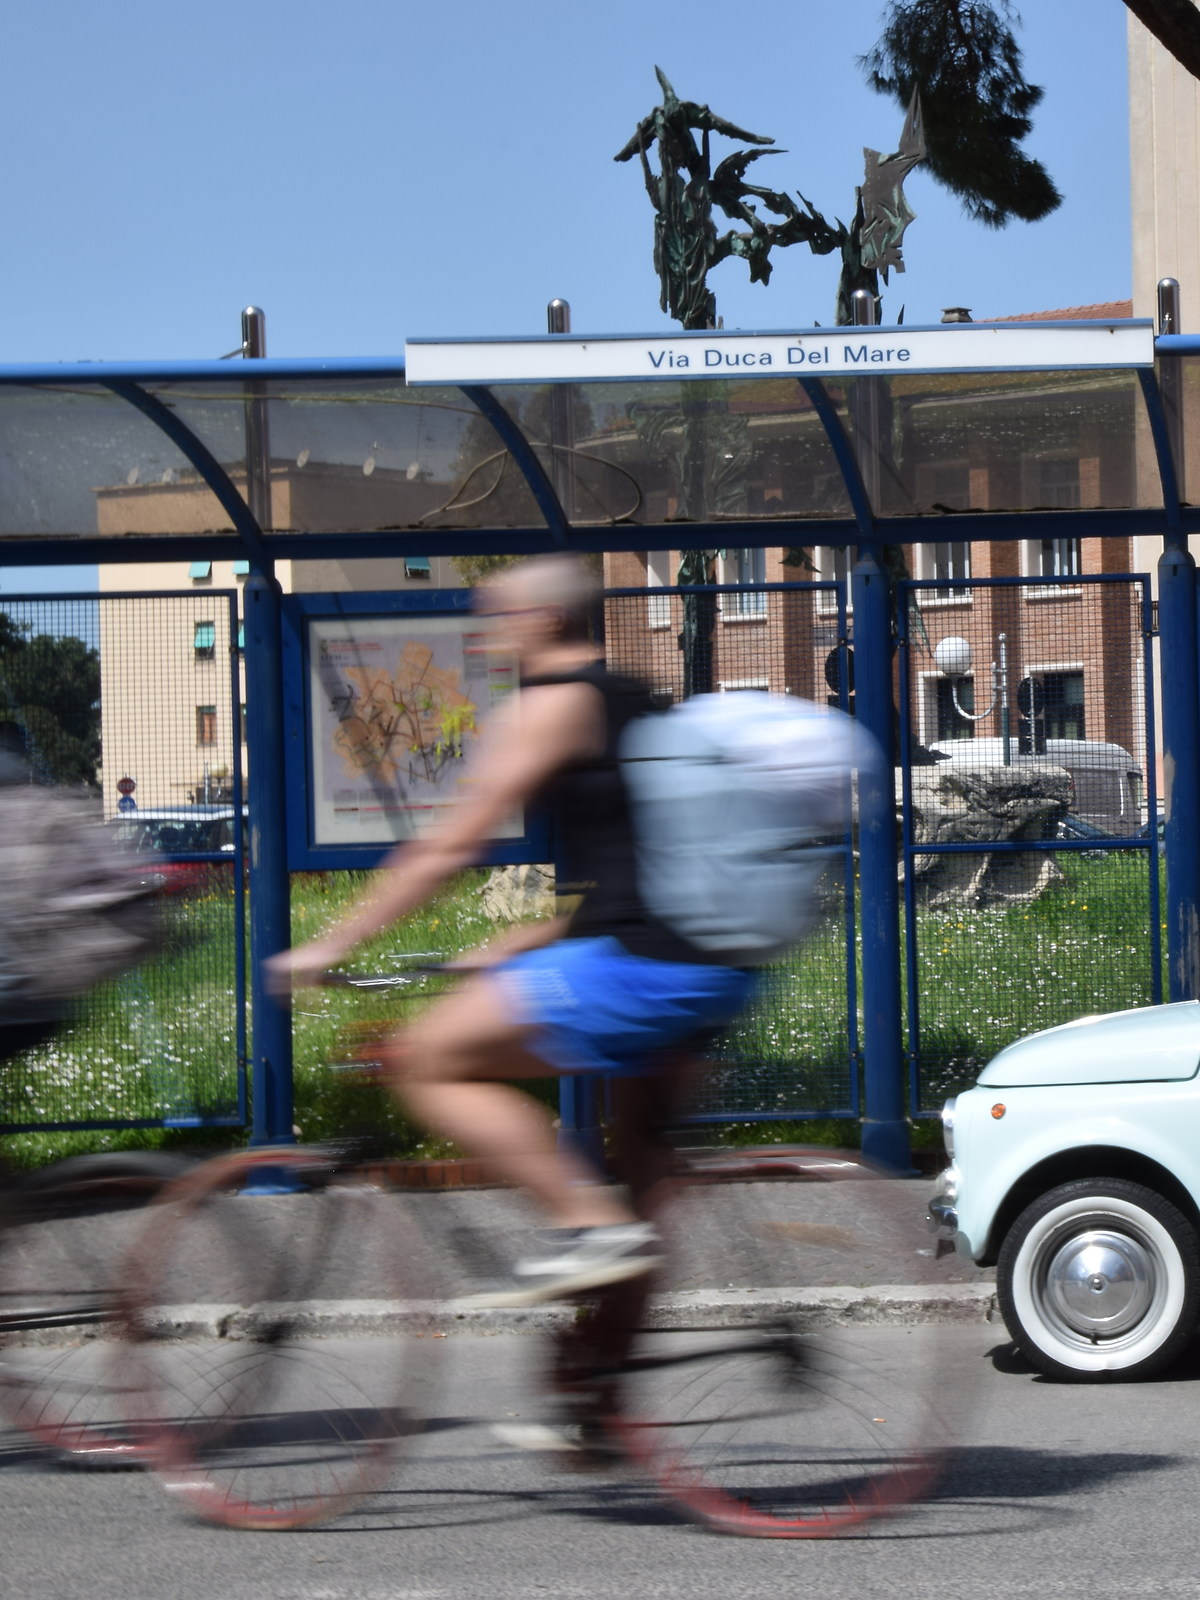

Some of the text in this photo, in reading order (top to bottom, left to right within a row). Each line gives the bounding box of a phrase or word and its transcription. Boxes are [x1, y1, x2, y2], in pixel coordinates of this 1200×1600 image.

[648, 345, 911, 368] Via Duca Del Mare
